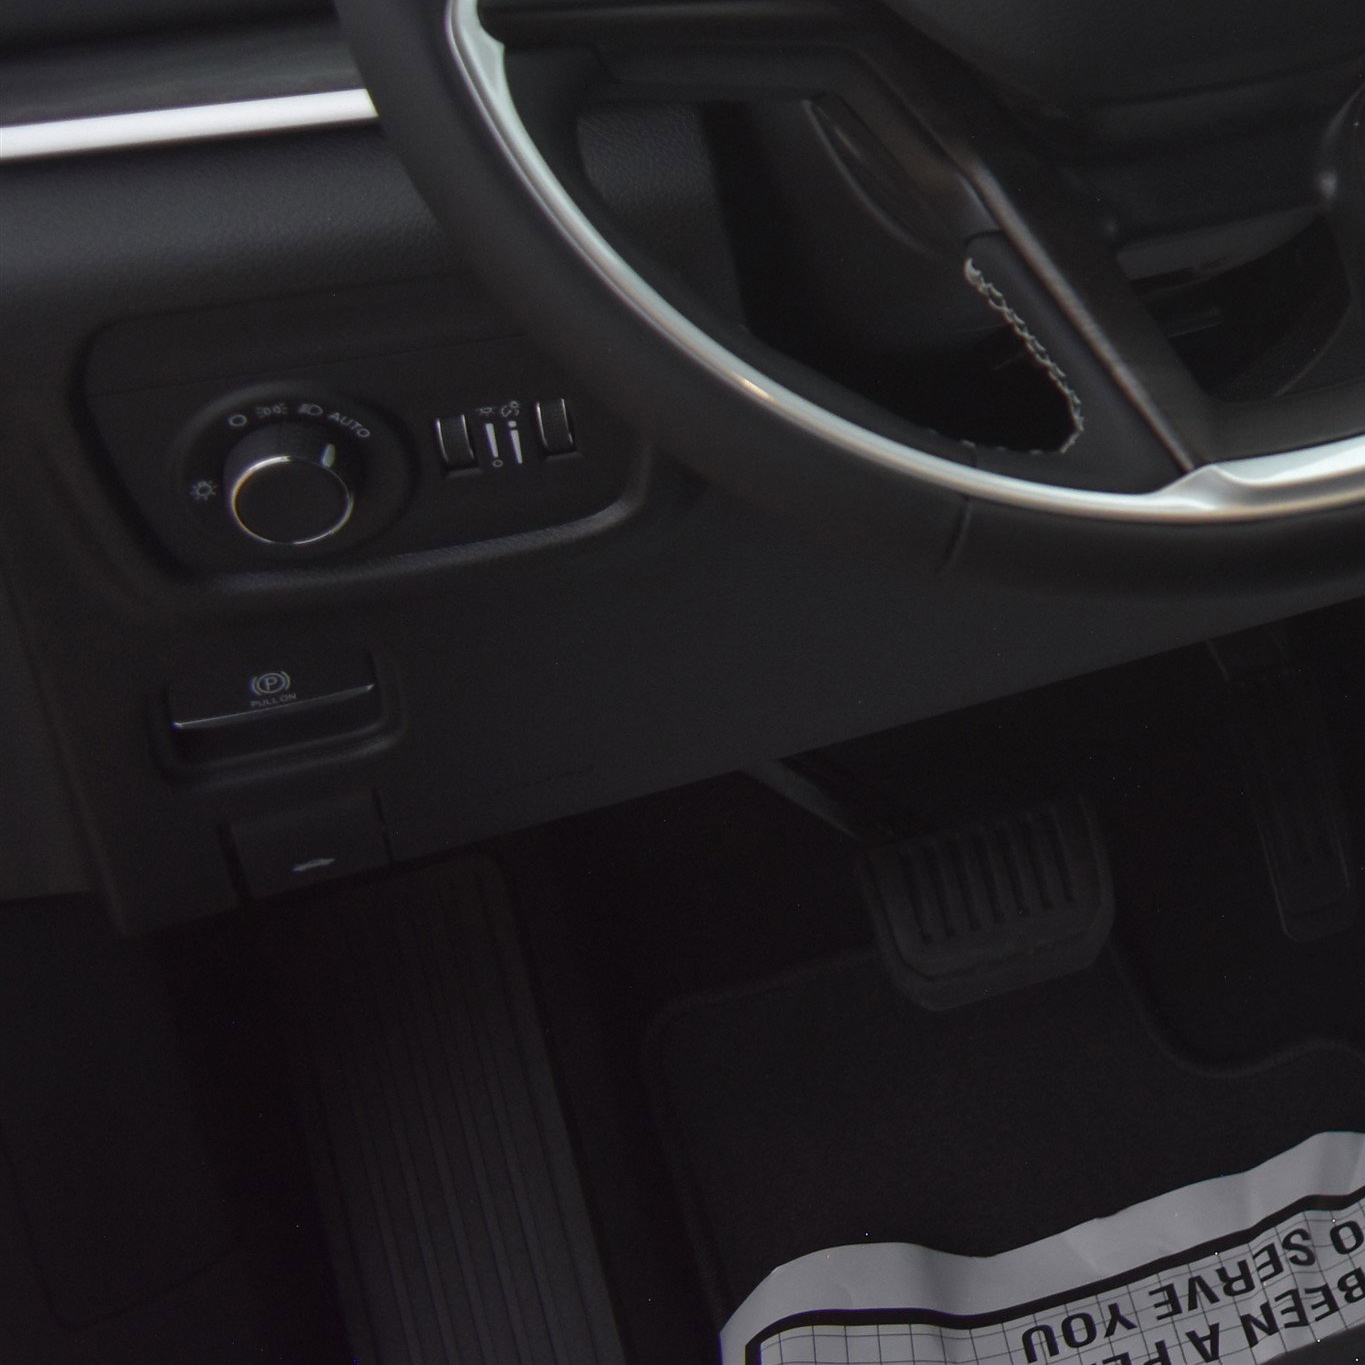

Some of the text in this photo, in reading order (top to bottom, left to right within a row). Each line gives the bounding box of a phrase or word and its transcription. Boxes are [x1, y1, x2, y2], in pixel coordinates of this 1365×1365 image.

[327, 411, 372, 438] AUTO
[248, 692, 297, 708] PULL ON
[1148, 1226, 1317, 1322] SERVE
[1021, 1301, 1138, 1365] YOU
